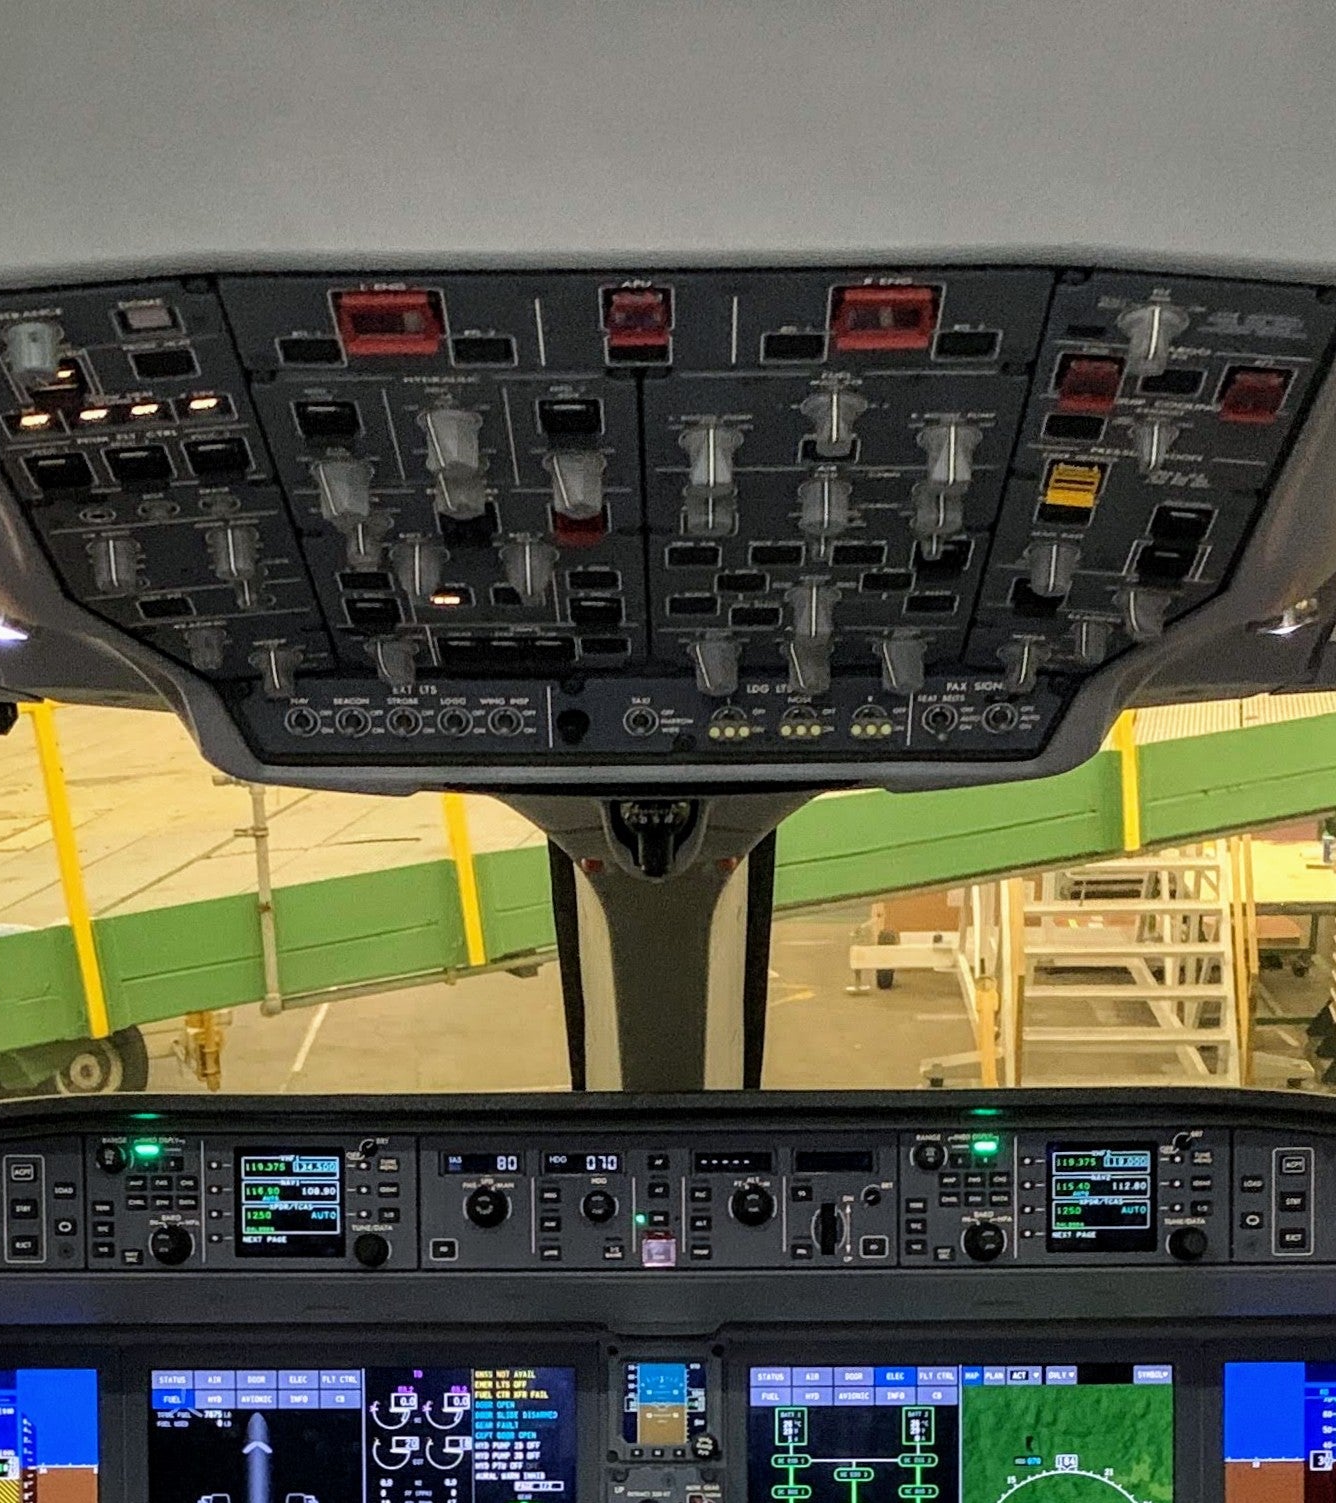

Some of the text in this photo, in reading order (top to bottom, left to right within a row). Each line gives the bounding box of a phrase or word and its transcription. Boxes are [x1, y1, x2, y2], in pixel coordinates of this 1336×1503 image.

[496, 1155, 518, 1171] 80
[586, 1155, 618, 1171] 070
[1121, 1206, 1147, 1214] AUTO
[311, 1211, 337, 1219] AUTO
[159, 1375, 187, 1384] STATUS
[758, 1372, 785, 1381] STATUS
